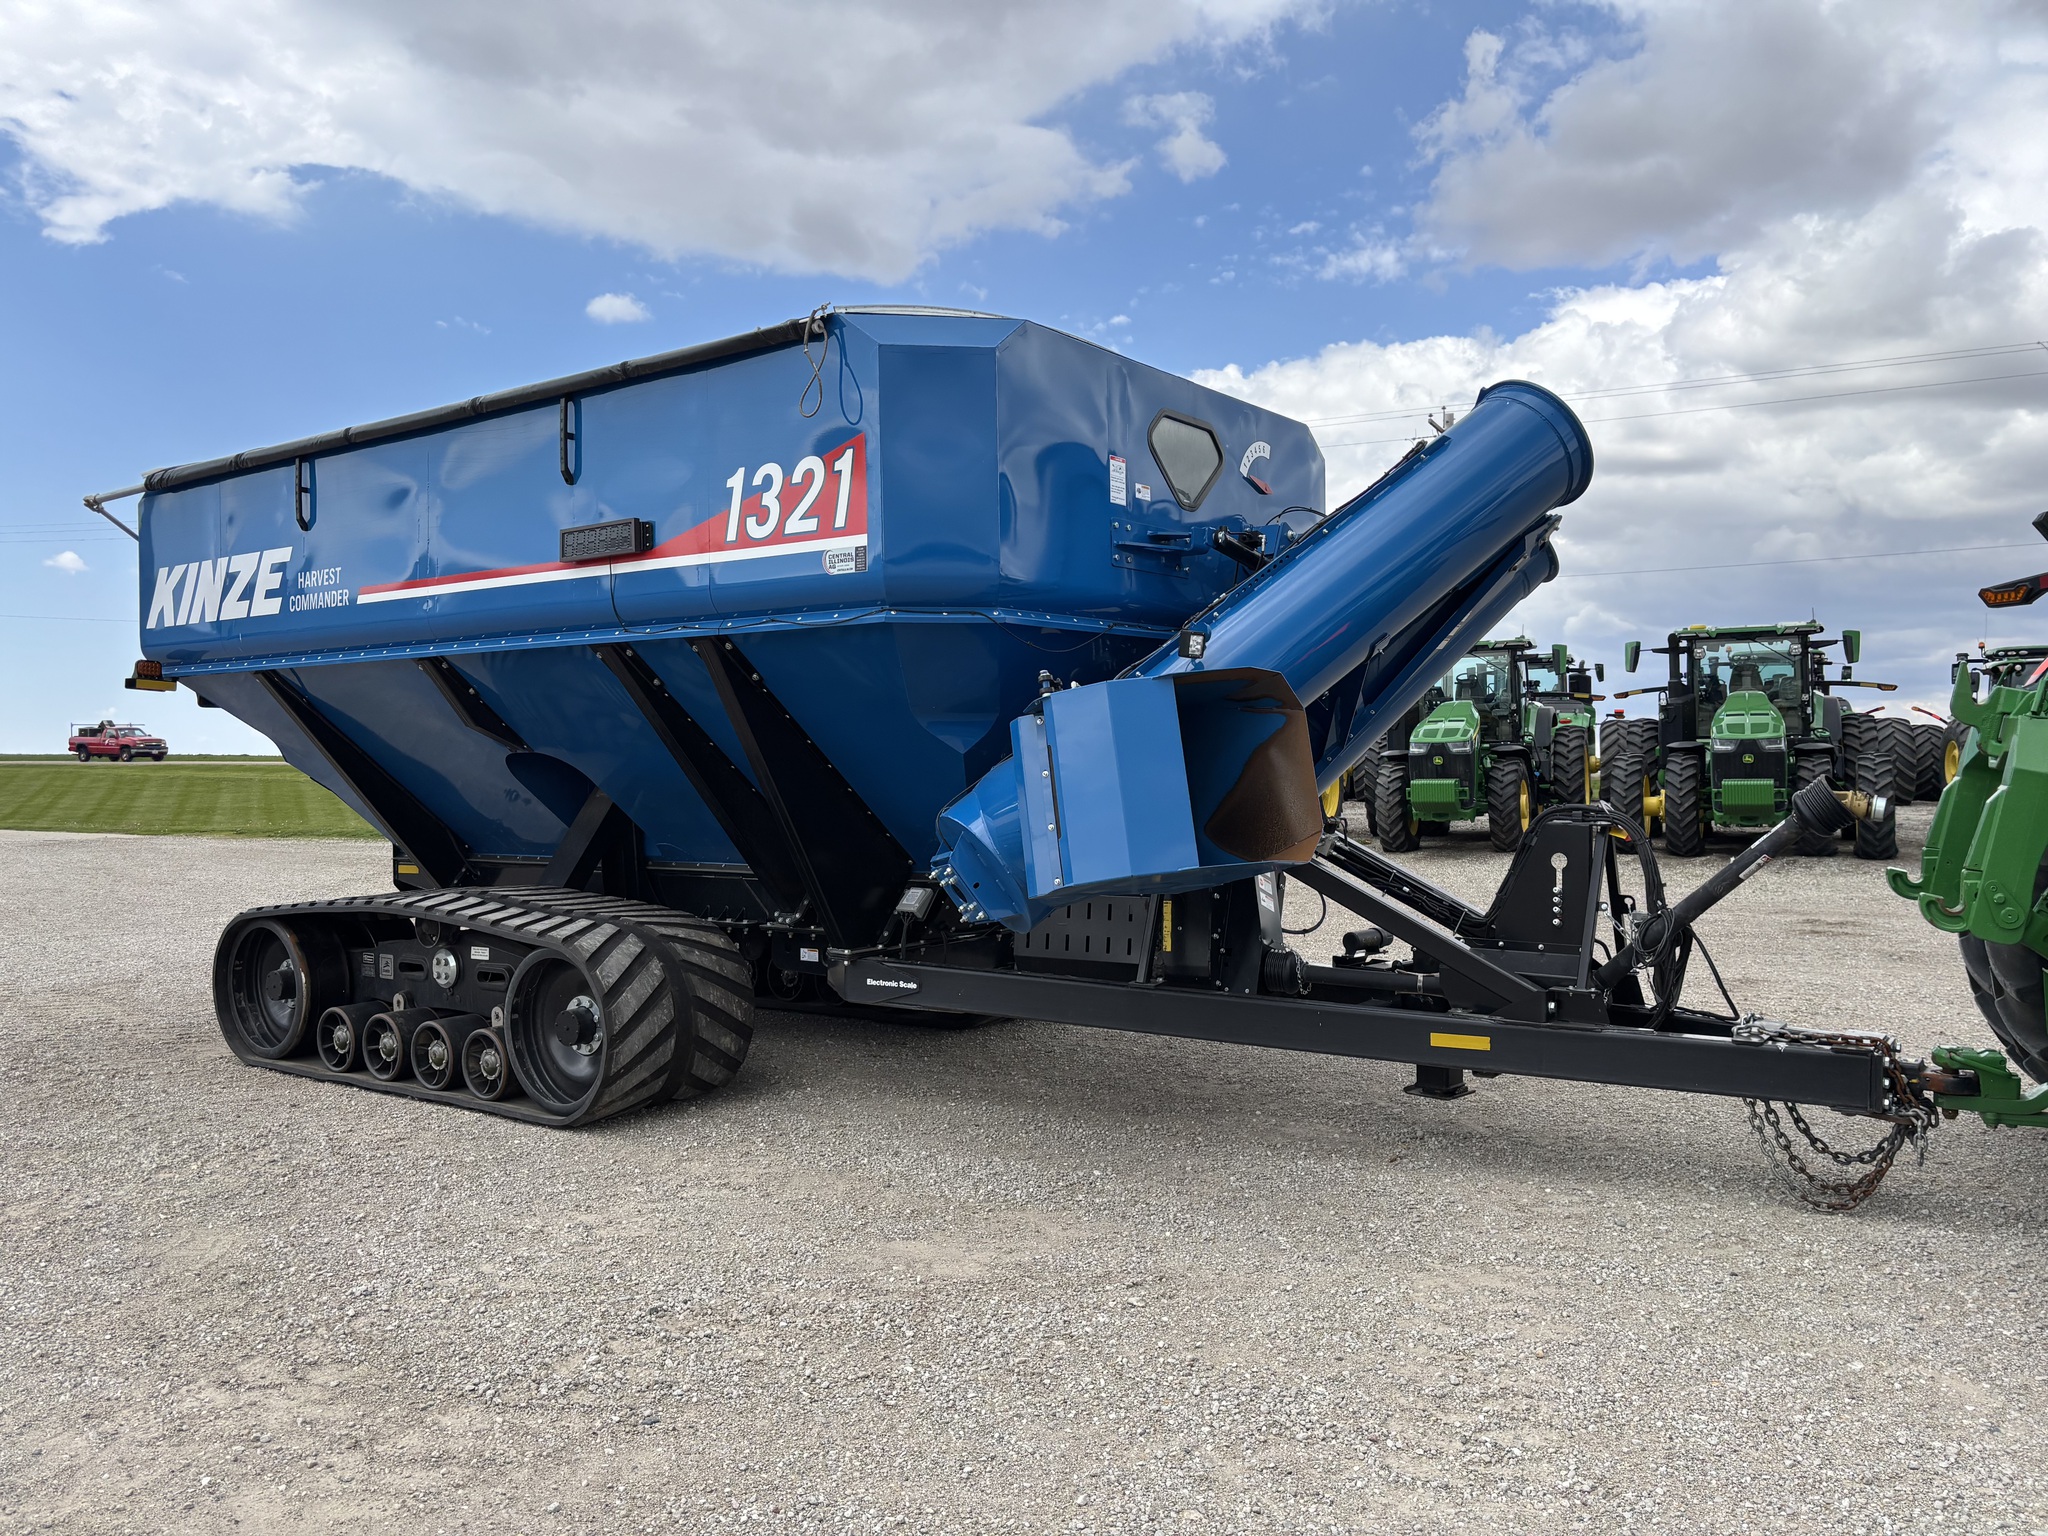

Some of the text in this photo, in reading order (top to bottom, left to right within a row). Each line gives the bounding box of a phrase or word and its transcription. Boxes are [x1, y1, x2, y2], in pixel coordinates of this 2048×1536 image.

[726, 448, 854, 542] 1321
[146, 546, 293, 629] KINZE
[298, 567, 342, 589] HARVEST
[289, 589, 350, 613] COMMANDER
[866, 978, 918, 989] Electronic Scale
